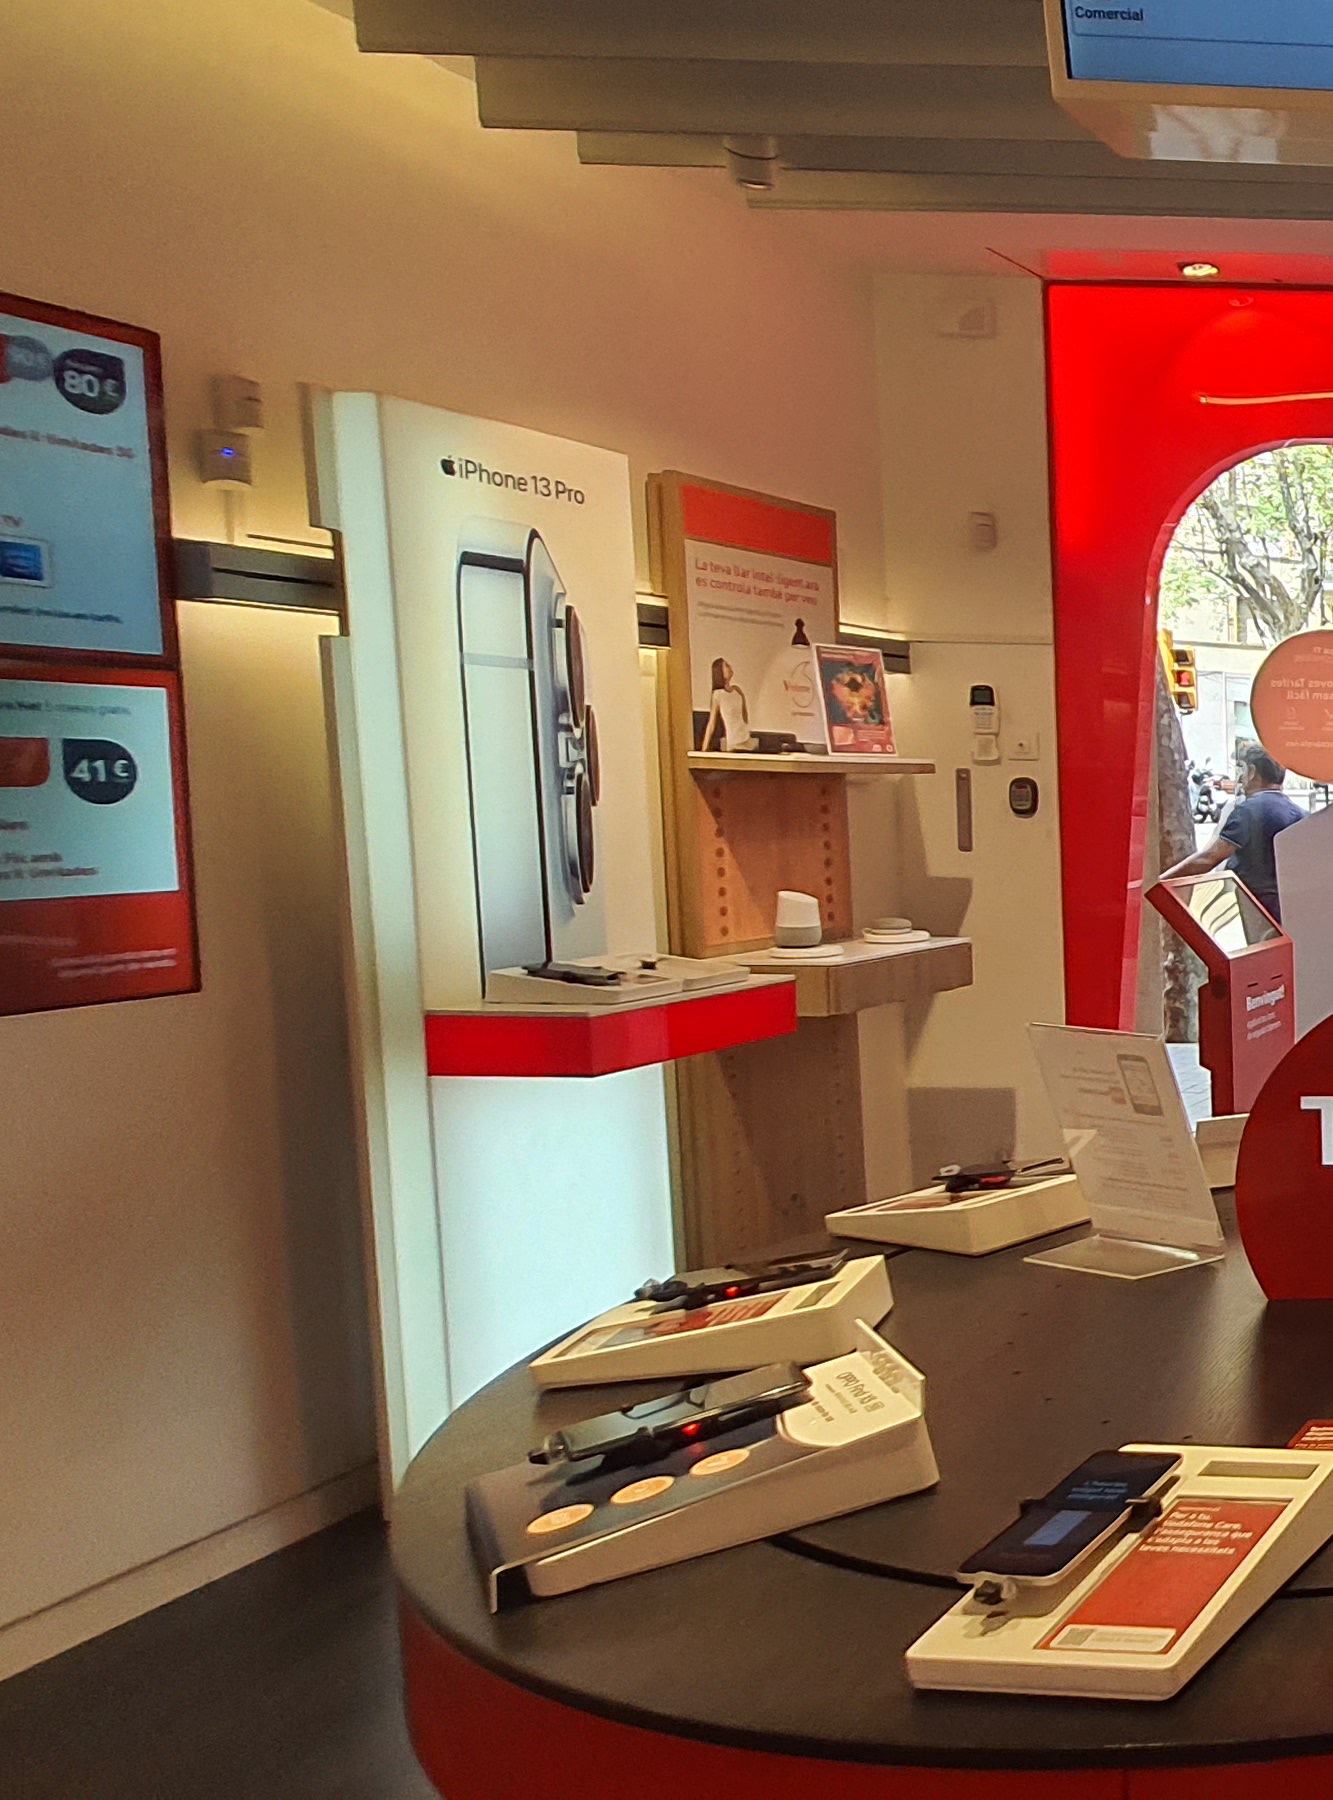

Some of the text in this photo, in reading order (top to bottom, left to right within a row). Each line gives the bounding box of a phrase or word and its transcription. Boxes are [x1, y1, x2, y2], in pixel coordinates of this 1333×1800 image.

[1075, 6, 1144, 21] Comercial
[458, 458, 585, 505] iPhone 13 Pro
[695, 559, 708, 571] La
[710, 562, 732, 575] teva
[710, 579, 752, 595] controla
